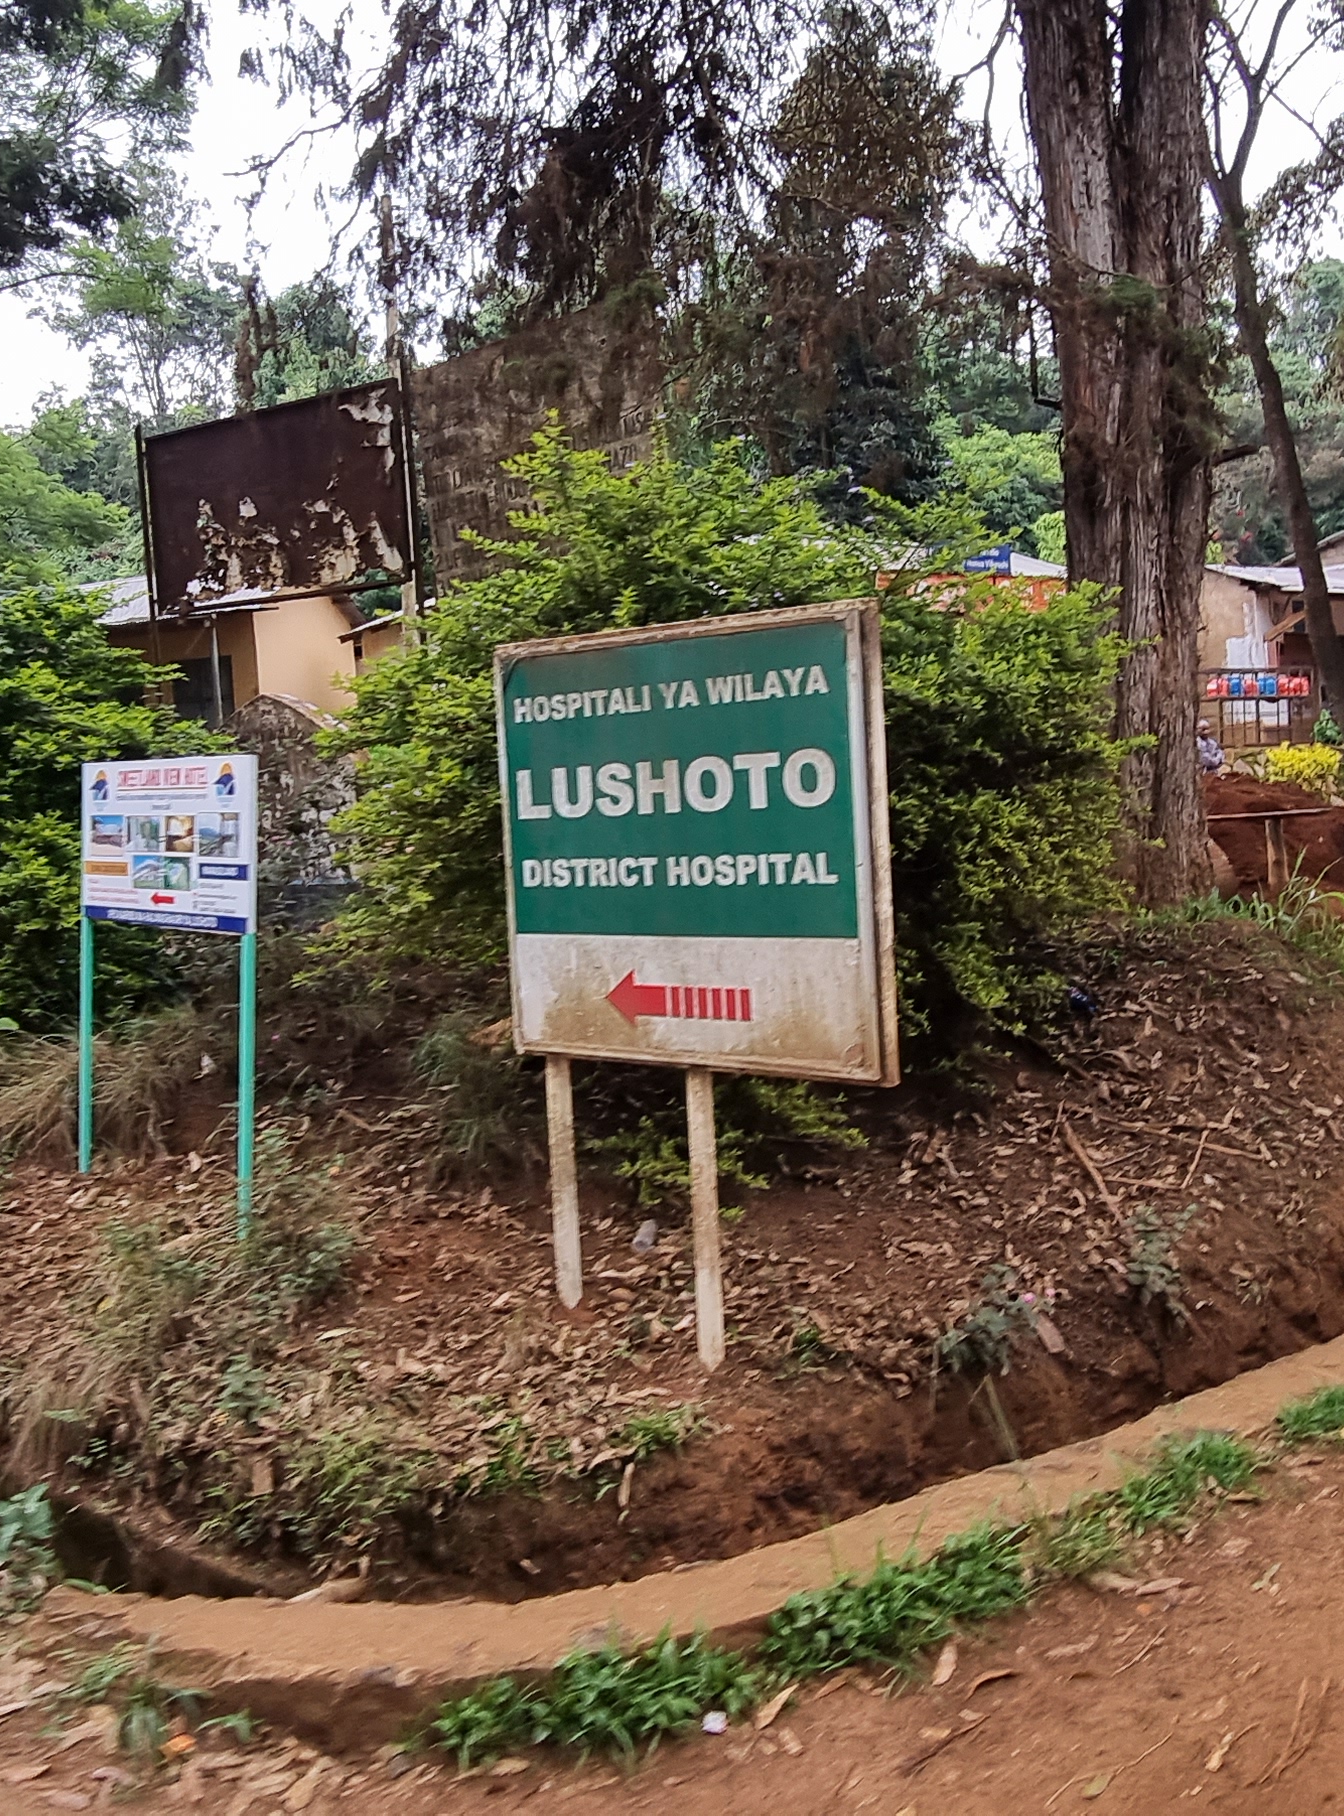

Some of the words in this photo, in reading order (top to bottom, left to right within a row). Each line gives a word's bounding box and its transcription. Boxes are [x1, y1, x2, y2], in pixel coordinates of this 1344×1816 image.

[513, 685, 652, 724] HOSPITALI
[658, 679, 700, 710] YA
[705, 664, 830, 705] WILAYA
[516, 747, 837, 821] LUSHOTO
[522, 856, 658, 889] DISTRICT
[666, 852, 839, 887] HOSPITAL
